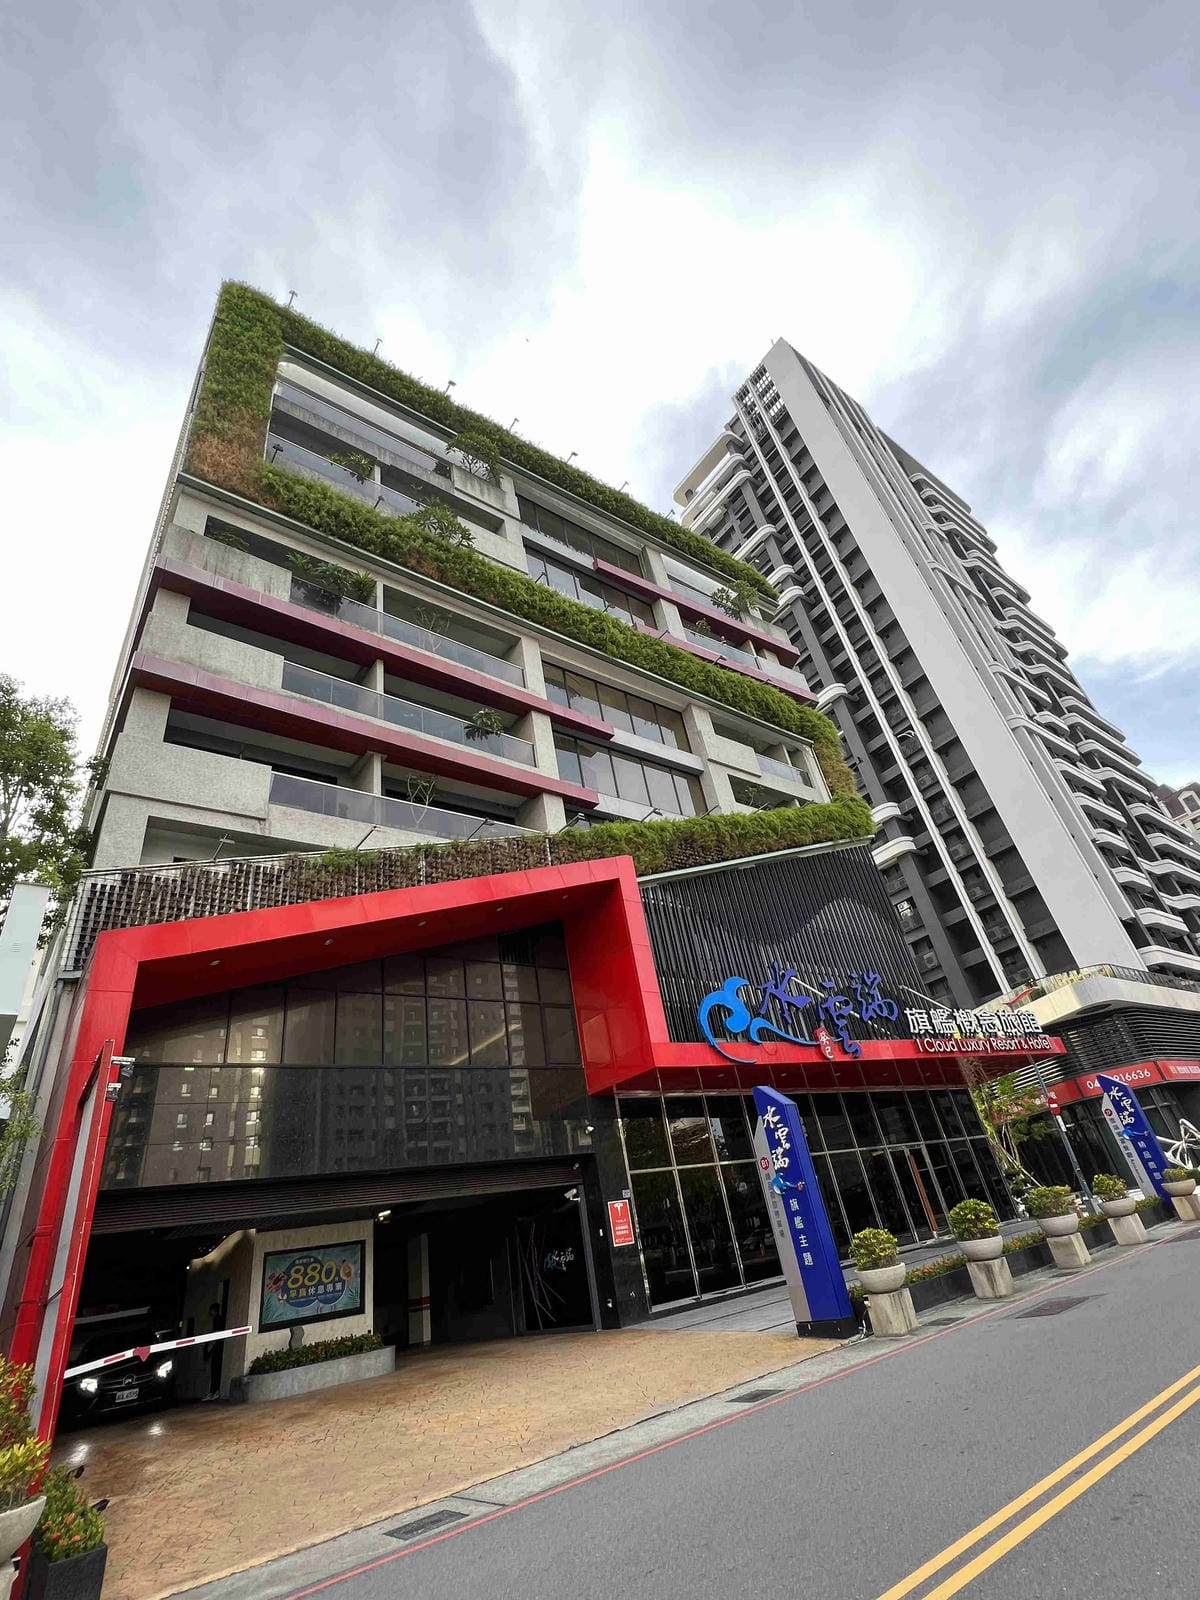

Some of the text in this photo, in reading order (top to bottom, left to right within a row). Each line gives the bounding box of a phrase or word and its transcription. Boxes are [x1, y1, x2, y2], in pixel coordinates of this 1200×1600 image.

[904, 1007, 1043, 1034] 旗艦概念旅館
[924, 1038, 958, 1053] Cloud
[958, 1037, 991, 1054] Luxury
[991, 1036, 1021, 1051] Resort
[1021, 1039, 1028, 1050] &
[1028, 1034, 1052, 1049] Hotel
[760, 1158, 769, 1169] B1
[287, 1261, 337, 1289] 880
